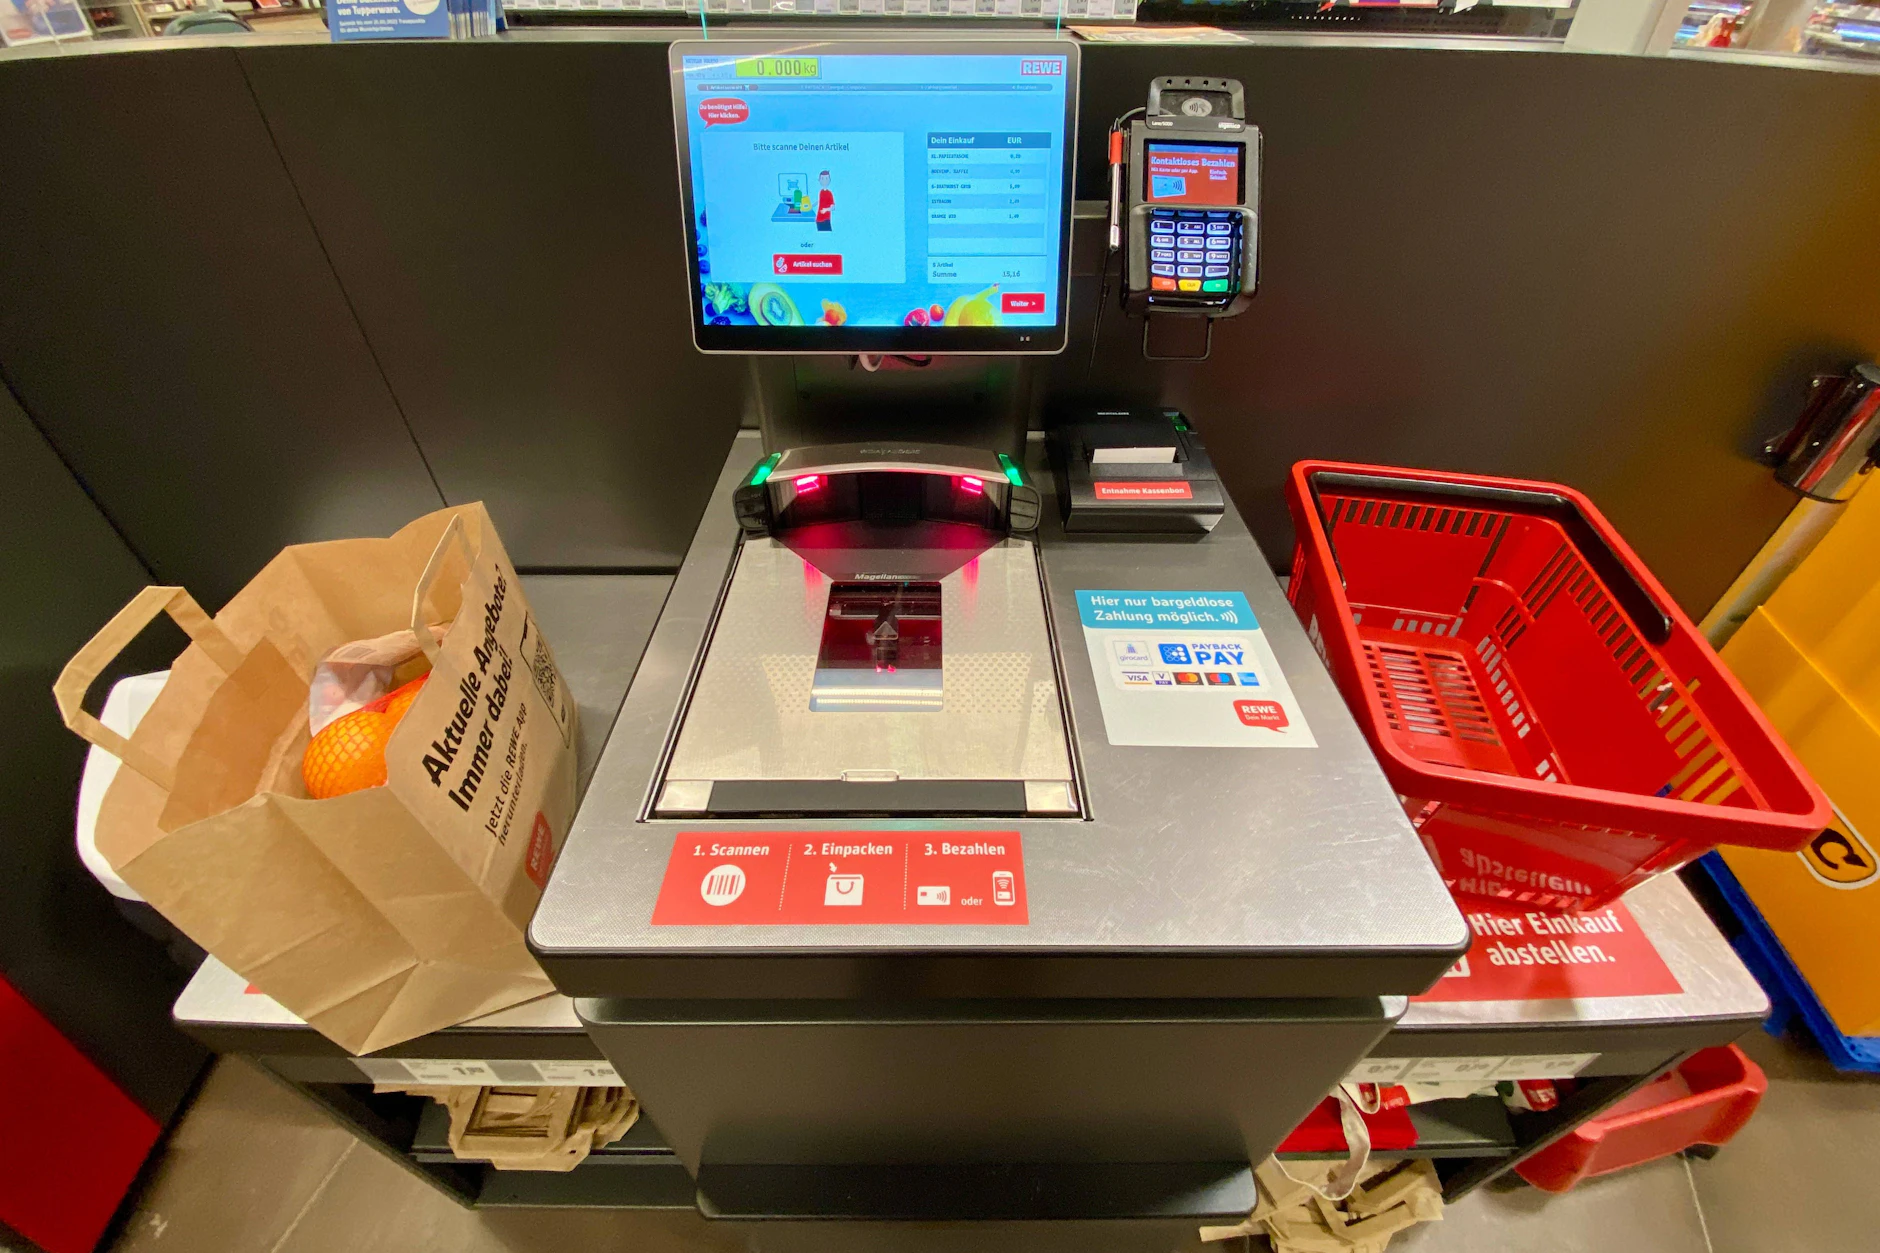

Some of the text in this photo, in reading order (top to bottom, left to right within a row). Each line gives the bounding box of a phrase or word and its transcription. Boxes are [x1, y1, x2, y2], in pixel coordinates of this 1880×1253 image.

[338, 5, 400, 17] von Tupperware.
[756, 59, 817, 76] 0.000 kg
[1022, 61, 1060, 74] REWE
[753, 143, 771, 151] Bitte
[798, 143, 824, 151] Deinen
[825, 143, 849, 151] Artikel
[931, 136, 975, 144] Dein Einkauf
[1007, 136, 1022, 144] EUR
[1151, 156, 1236, 168] Kontaktloses Bezahlen
[1091, 595, 1234, 609] Hier nur bargeldlose
[1094, 610, 1219, 624] Zahlung möglich.
[1194, 651, 1244, 665] PAY
[1241, 705, 1278, 714] REWE
[422, 671, 482, 788] Aktuelle
[448, 644, 513, 813] Immer dabei!
[485, 702, 528, 838] Jetzt die REWE App
[498, 743, 528, 847] herunterladen.
[693, 844, 769, 856] 1. Scannen
[804, 844, 893, 858] 2. Einpacken
[924, 843, 1006, 856] 3. Bezahlen
[961, 896, 983, 905] oder
[1467, 909, 1624, 936] Hier Einkauf
[1486, 940, 1616, 966] abstellen.
